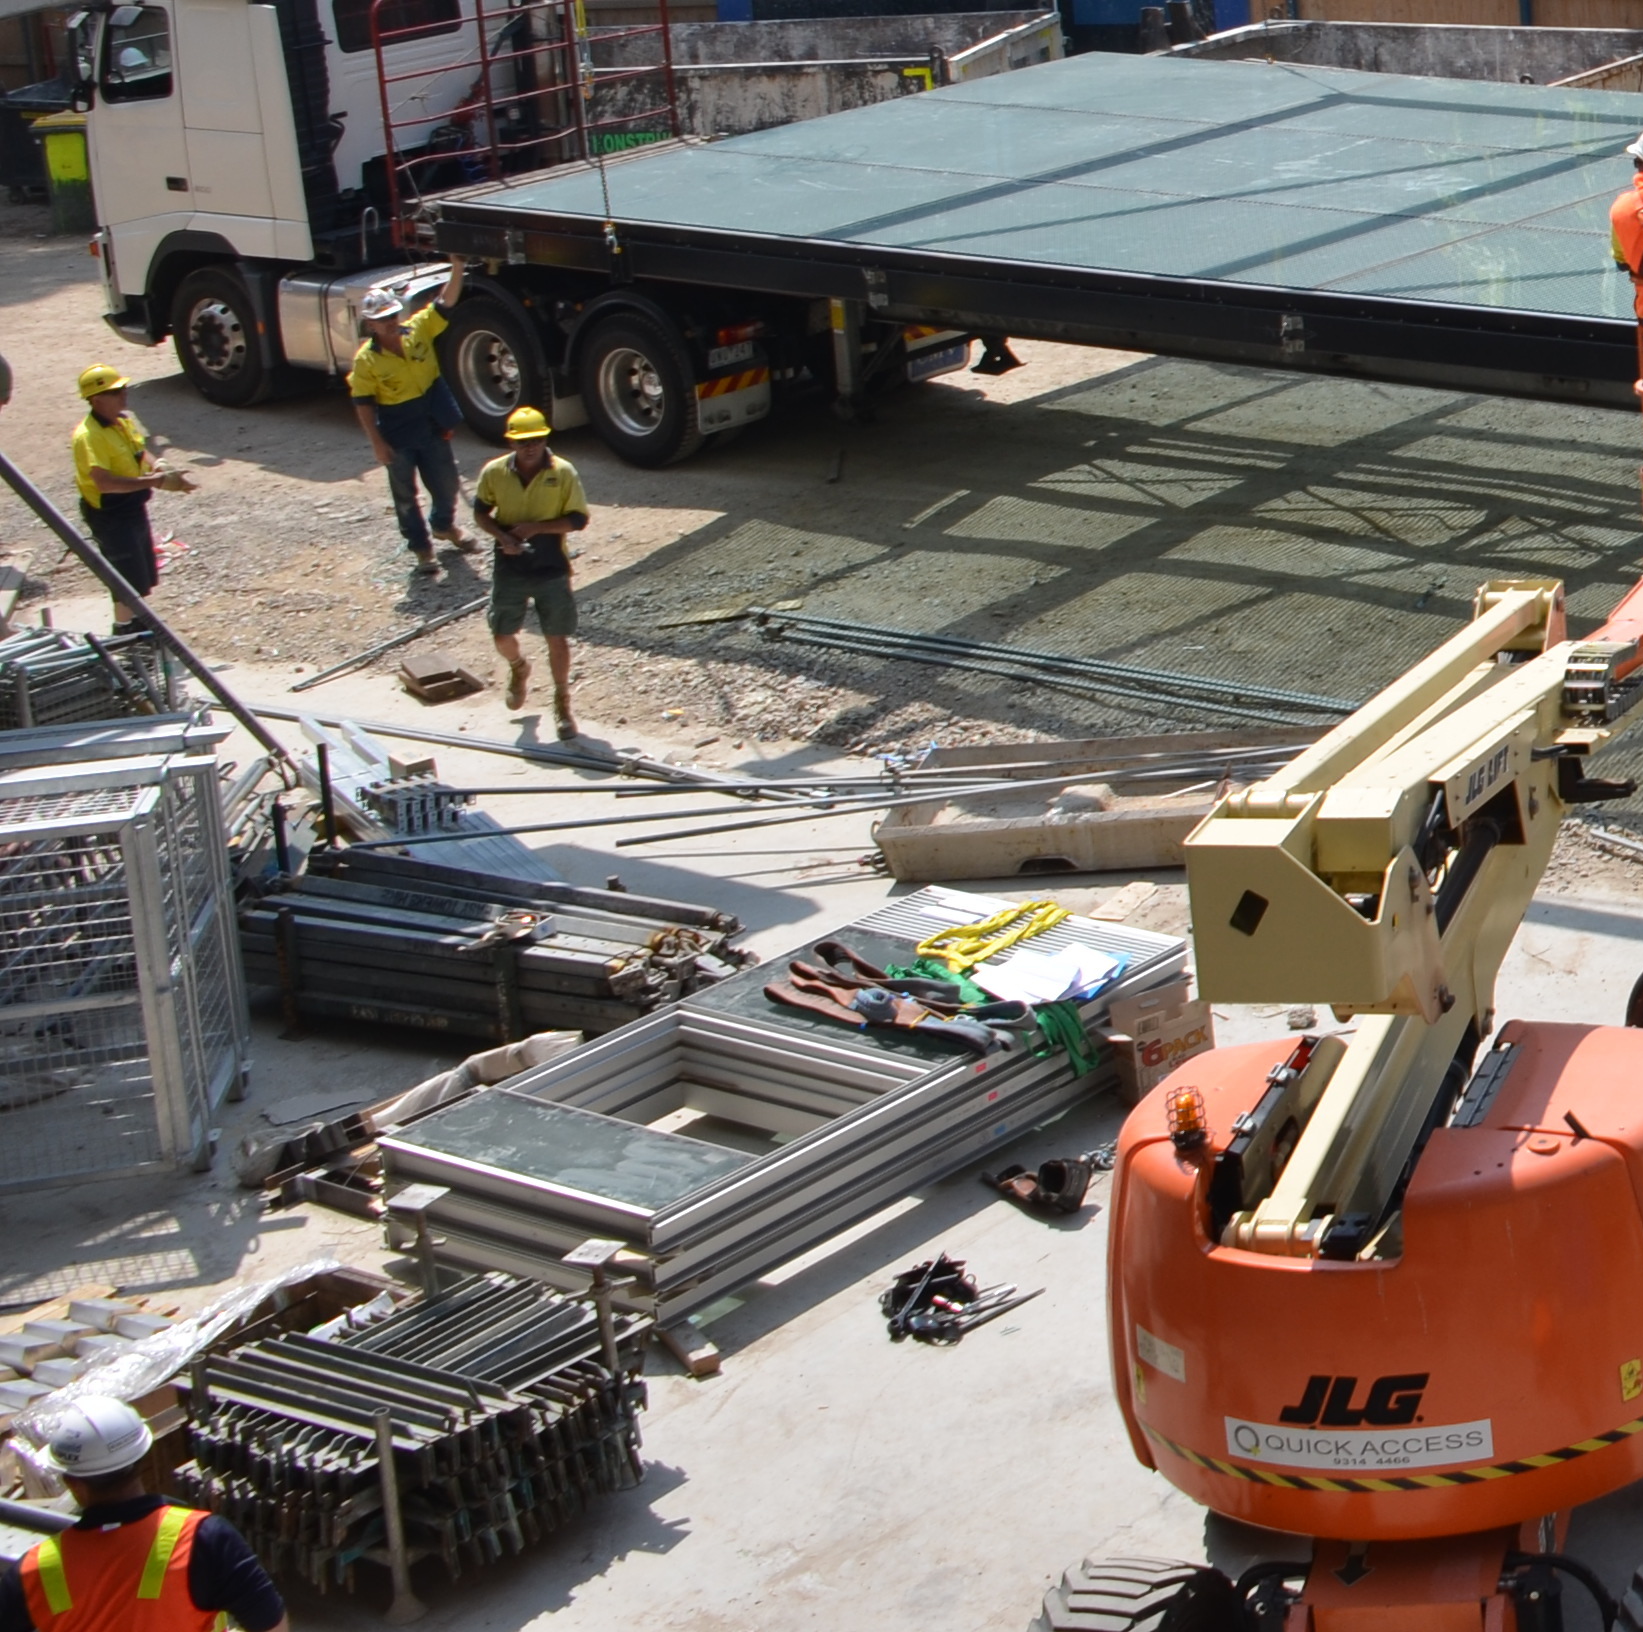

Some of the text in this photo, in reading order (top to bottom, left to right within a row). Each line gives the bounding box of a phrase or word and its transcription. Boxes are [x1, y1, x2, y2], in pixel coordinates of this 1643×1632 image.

[1465, 745, 1509, 805] JLG LIFT
[1279, 1372, 1431, 1427] JLG
[1265, 1434, 1353, 1455] QUICK
[1359, 1431, 1484, 1456] ACCESS
[1333, 1456, 1411, 1466] 9314 4466
